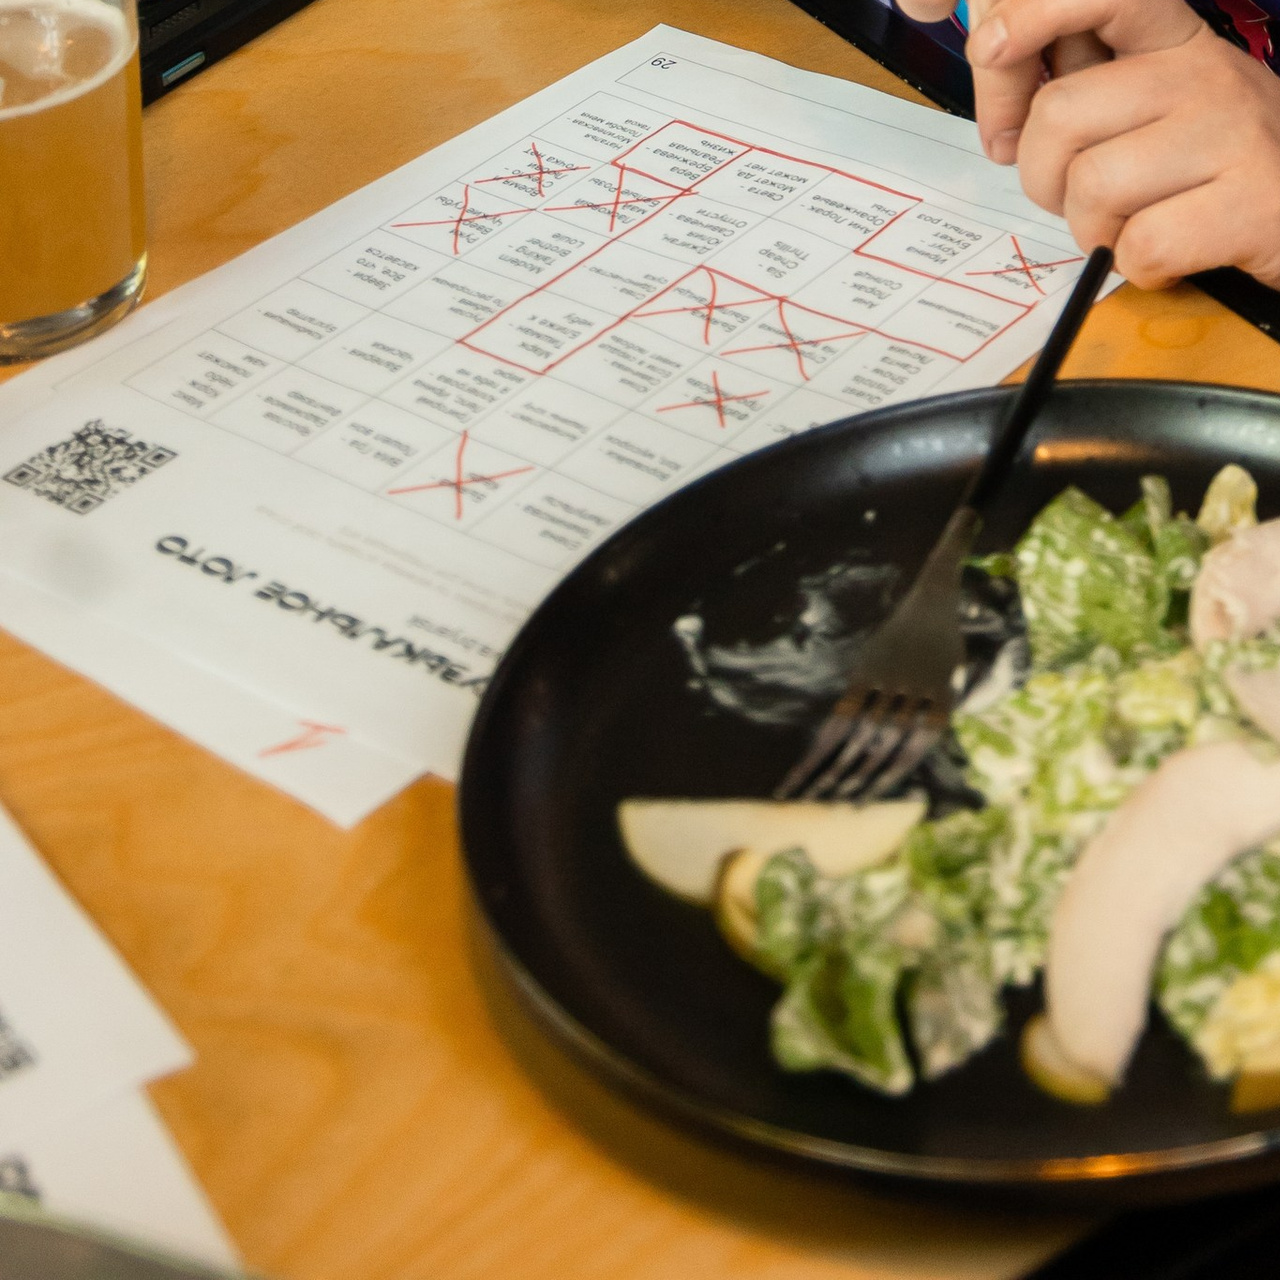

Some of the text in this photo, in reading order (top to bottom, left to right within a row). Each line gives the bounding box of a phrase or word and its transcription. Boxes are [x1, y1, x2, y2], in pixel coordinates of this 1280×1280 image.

[648, 56, 678, 70] 29
[572, 119, 632, 144] Могилевская
[580, 112, 642, 137] Полюби меня
[623, 118, 652, 131] такой
[583, 133, 623, 150] Наталья
[698, 139, 737, 156] жизнь
[652, 148, 713, 173] Брежнева
[668, 142, 725, 164] Реальная
[669, 166, 701, 180] Вера
[734, 169, 796, 193] Может да,
[743, 161, 809, 184] может нет
[502, 178, 542, 197] Время
[747, 187, 784, 201] Света
[621, 202, 648, 215] май
[812, 195, 885, 226] Оранжевые
[871, 203, 897, 216] сны
[676, 214, 735, 237] Савичева
[696, 209, 748, 228] Отпусти
[807, 205, 873, 235] Ани Лорак
[915, 213, 982, 241] белых роз
[526, 238, 572, 257] Brother
[551, 233, 585, 248] Louie
[662, 234, 711, 255] Джиган,
[686, 231, 723, 246] Юлия
[932, 232, 971, 249] Букет
[364, 247, 419, 271] касается
[515, 245, 555, 265] Talking
[755, 248, 801, 270] Cheap
[770, 240, 811, 260] Thrills
[905, 246, 948, 264] Ирина
[926, 242, 960, 257] Круг
[354, 257, 407, 281] Все, что
[498, 254, 544, 274] Modern
[763, 266, 787, 278] Sia
[352, 272, 391, 290] Звери
[853, 270, 903, 290] Солнце
[850, 283, 891, 300] Лорак
[852, 297, 878, 309] Ани
[155, 536, 258, 584] ЛОТО
